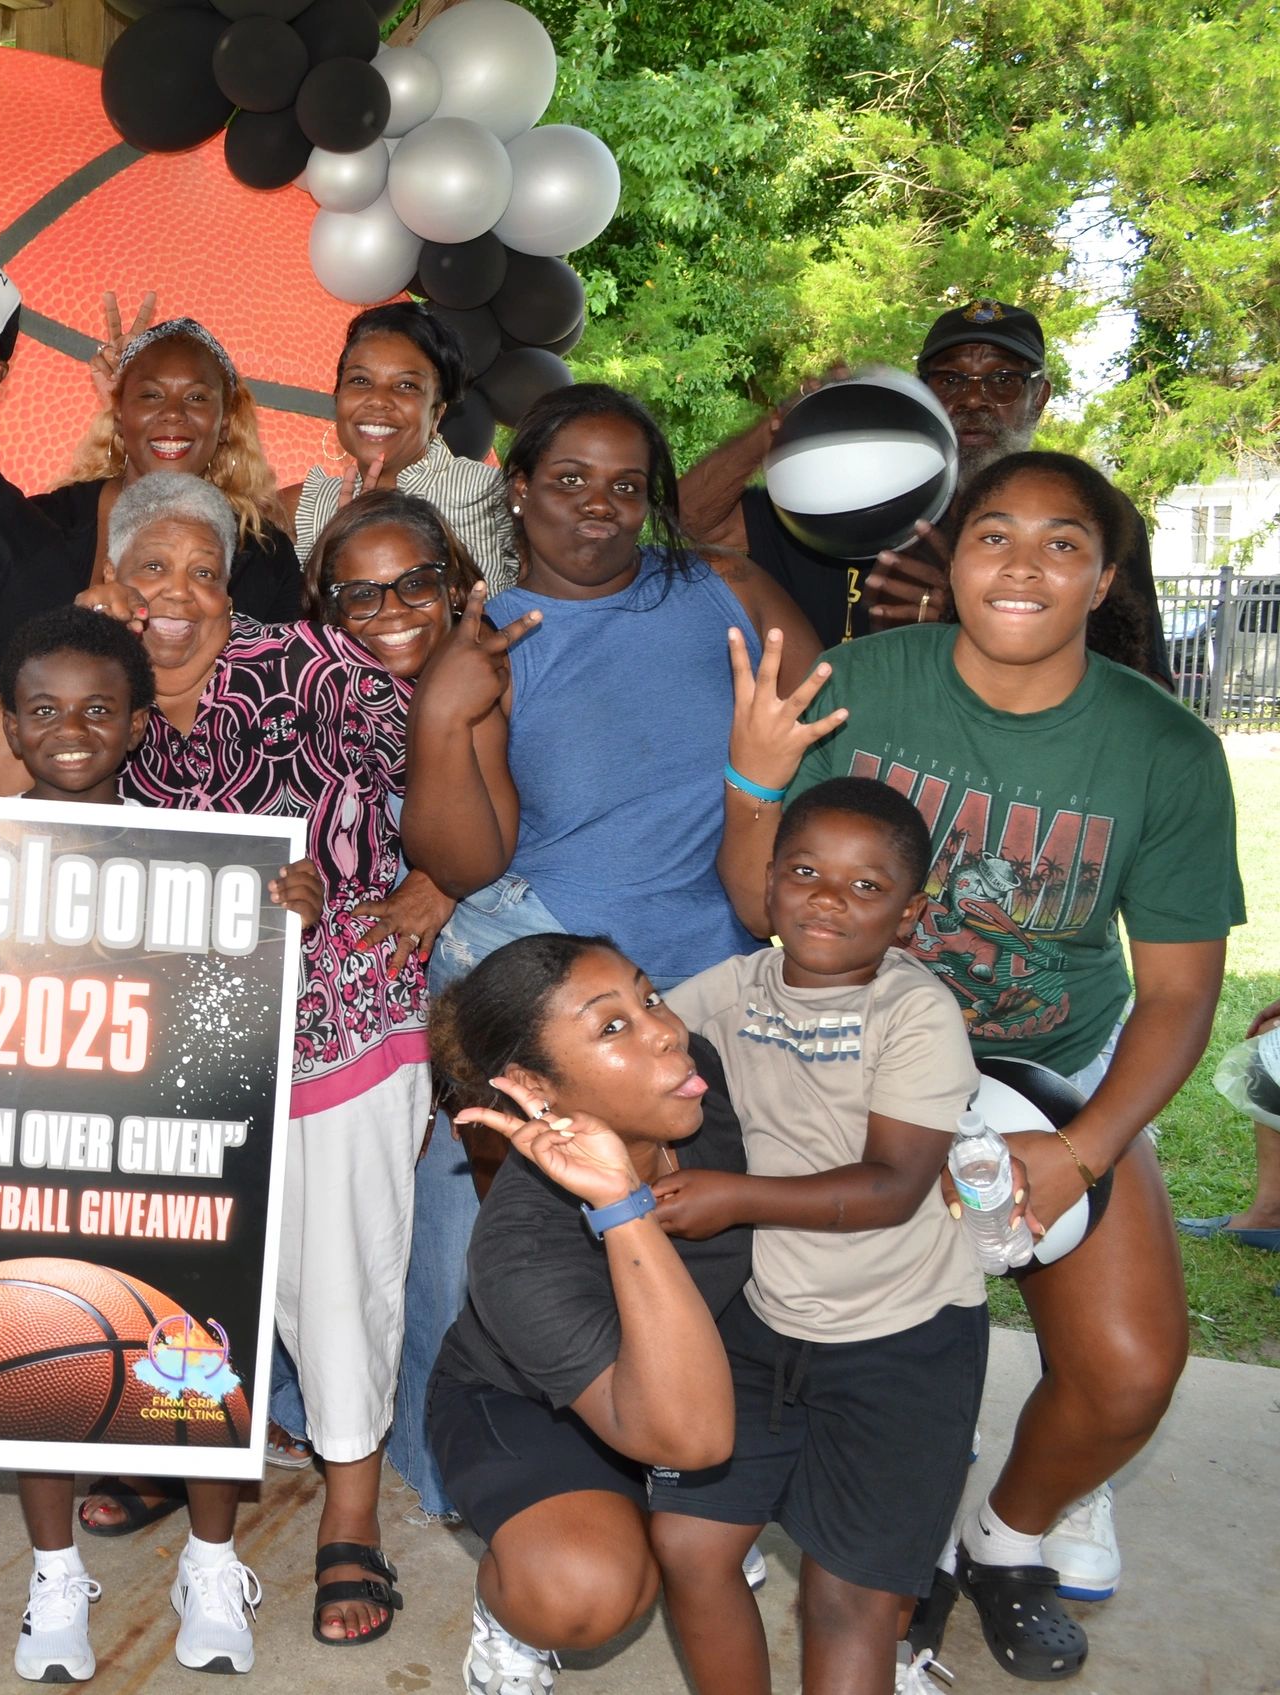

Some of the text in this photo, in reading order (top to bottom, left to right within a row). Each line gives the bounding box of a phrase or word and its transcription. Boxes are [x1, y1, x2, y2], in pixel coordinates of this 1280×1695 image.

[884, 741, 1043, 801] UNIVERSITY
[746, 1001, 863, 1041] UNDER
[737, 1023, 862, 1063] ARMOUR
[20, 1109, 114, 1172] OVER
[79, 1190, 234, 1242] GIVEAWAY
[140, 1407, 225, 1420] CONSULTING
[151, 1396, 219, 1409] FIRM GRIP
